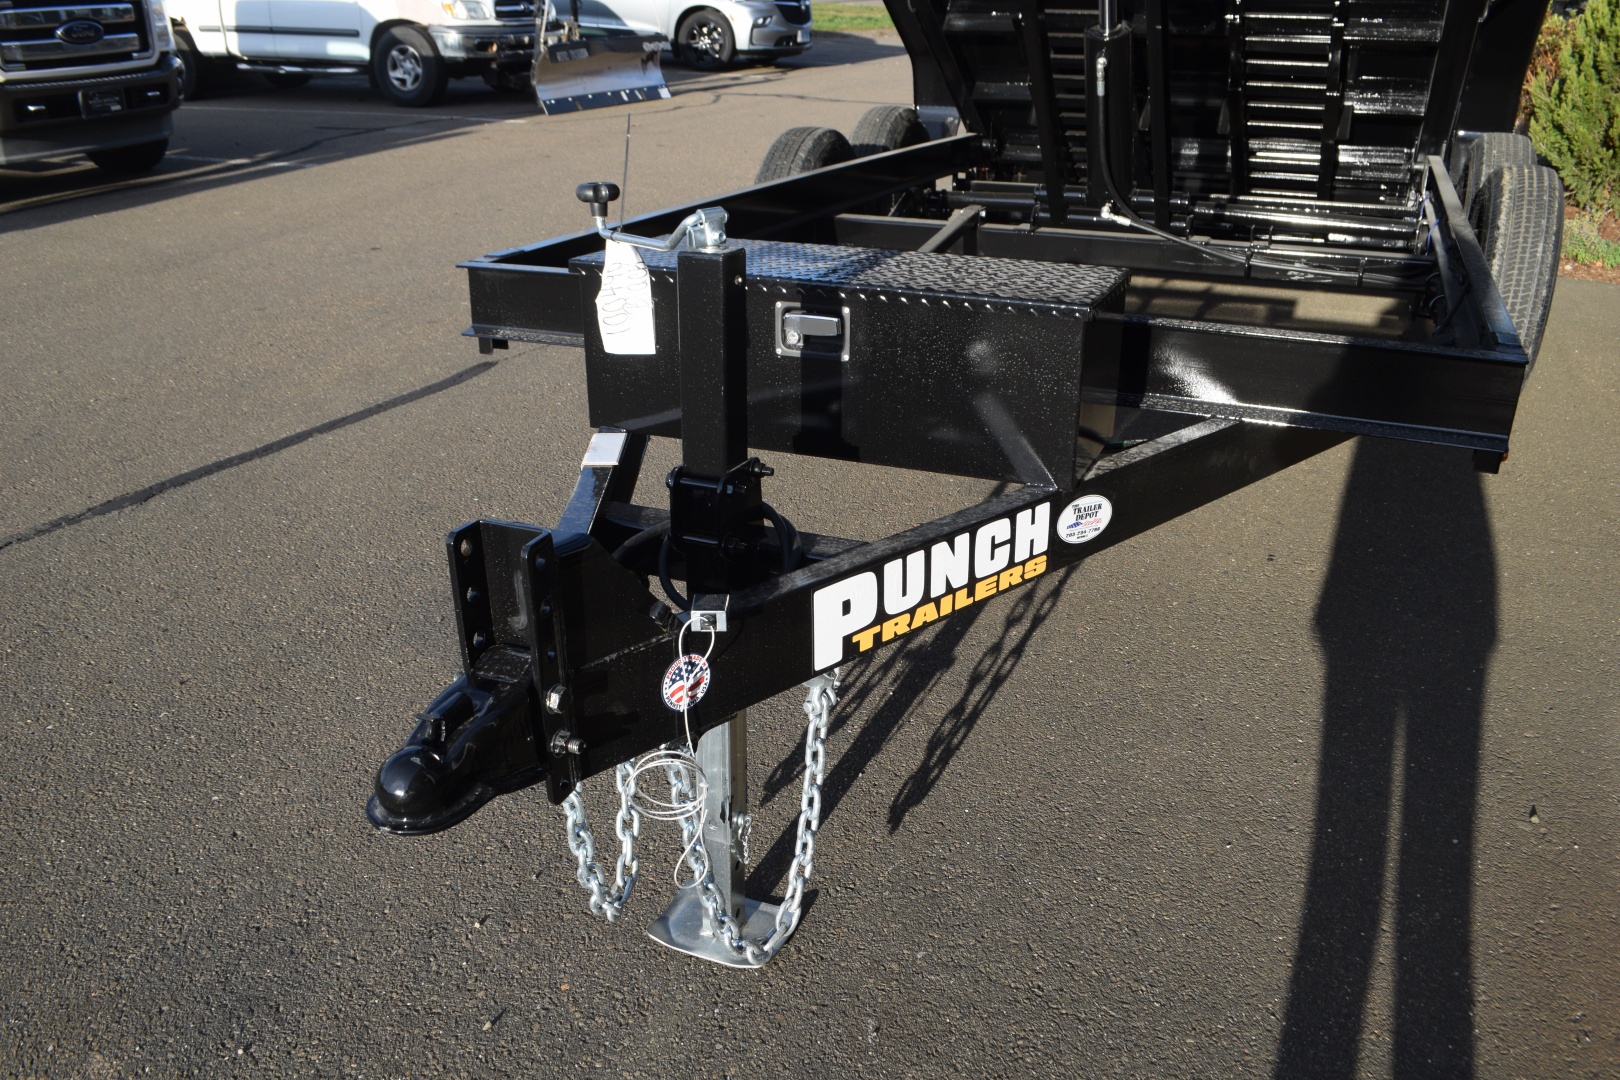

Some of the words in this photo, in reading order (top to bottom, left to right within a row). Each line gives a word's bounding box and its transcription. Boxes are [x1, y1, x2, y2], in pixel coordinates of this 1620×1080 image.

[1073, 503, 1103, 515] TRAILER
[1075, 510, 1099, 521] DEPOT
[813, 501, 1050, 672] PUNCH
[852, 554, 1048, 653] TRAILERS
[666, 656, 687, 680] PROUDY
[701, 681, 709, 695] USA
